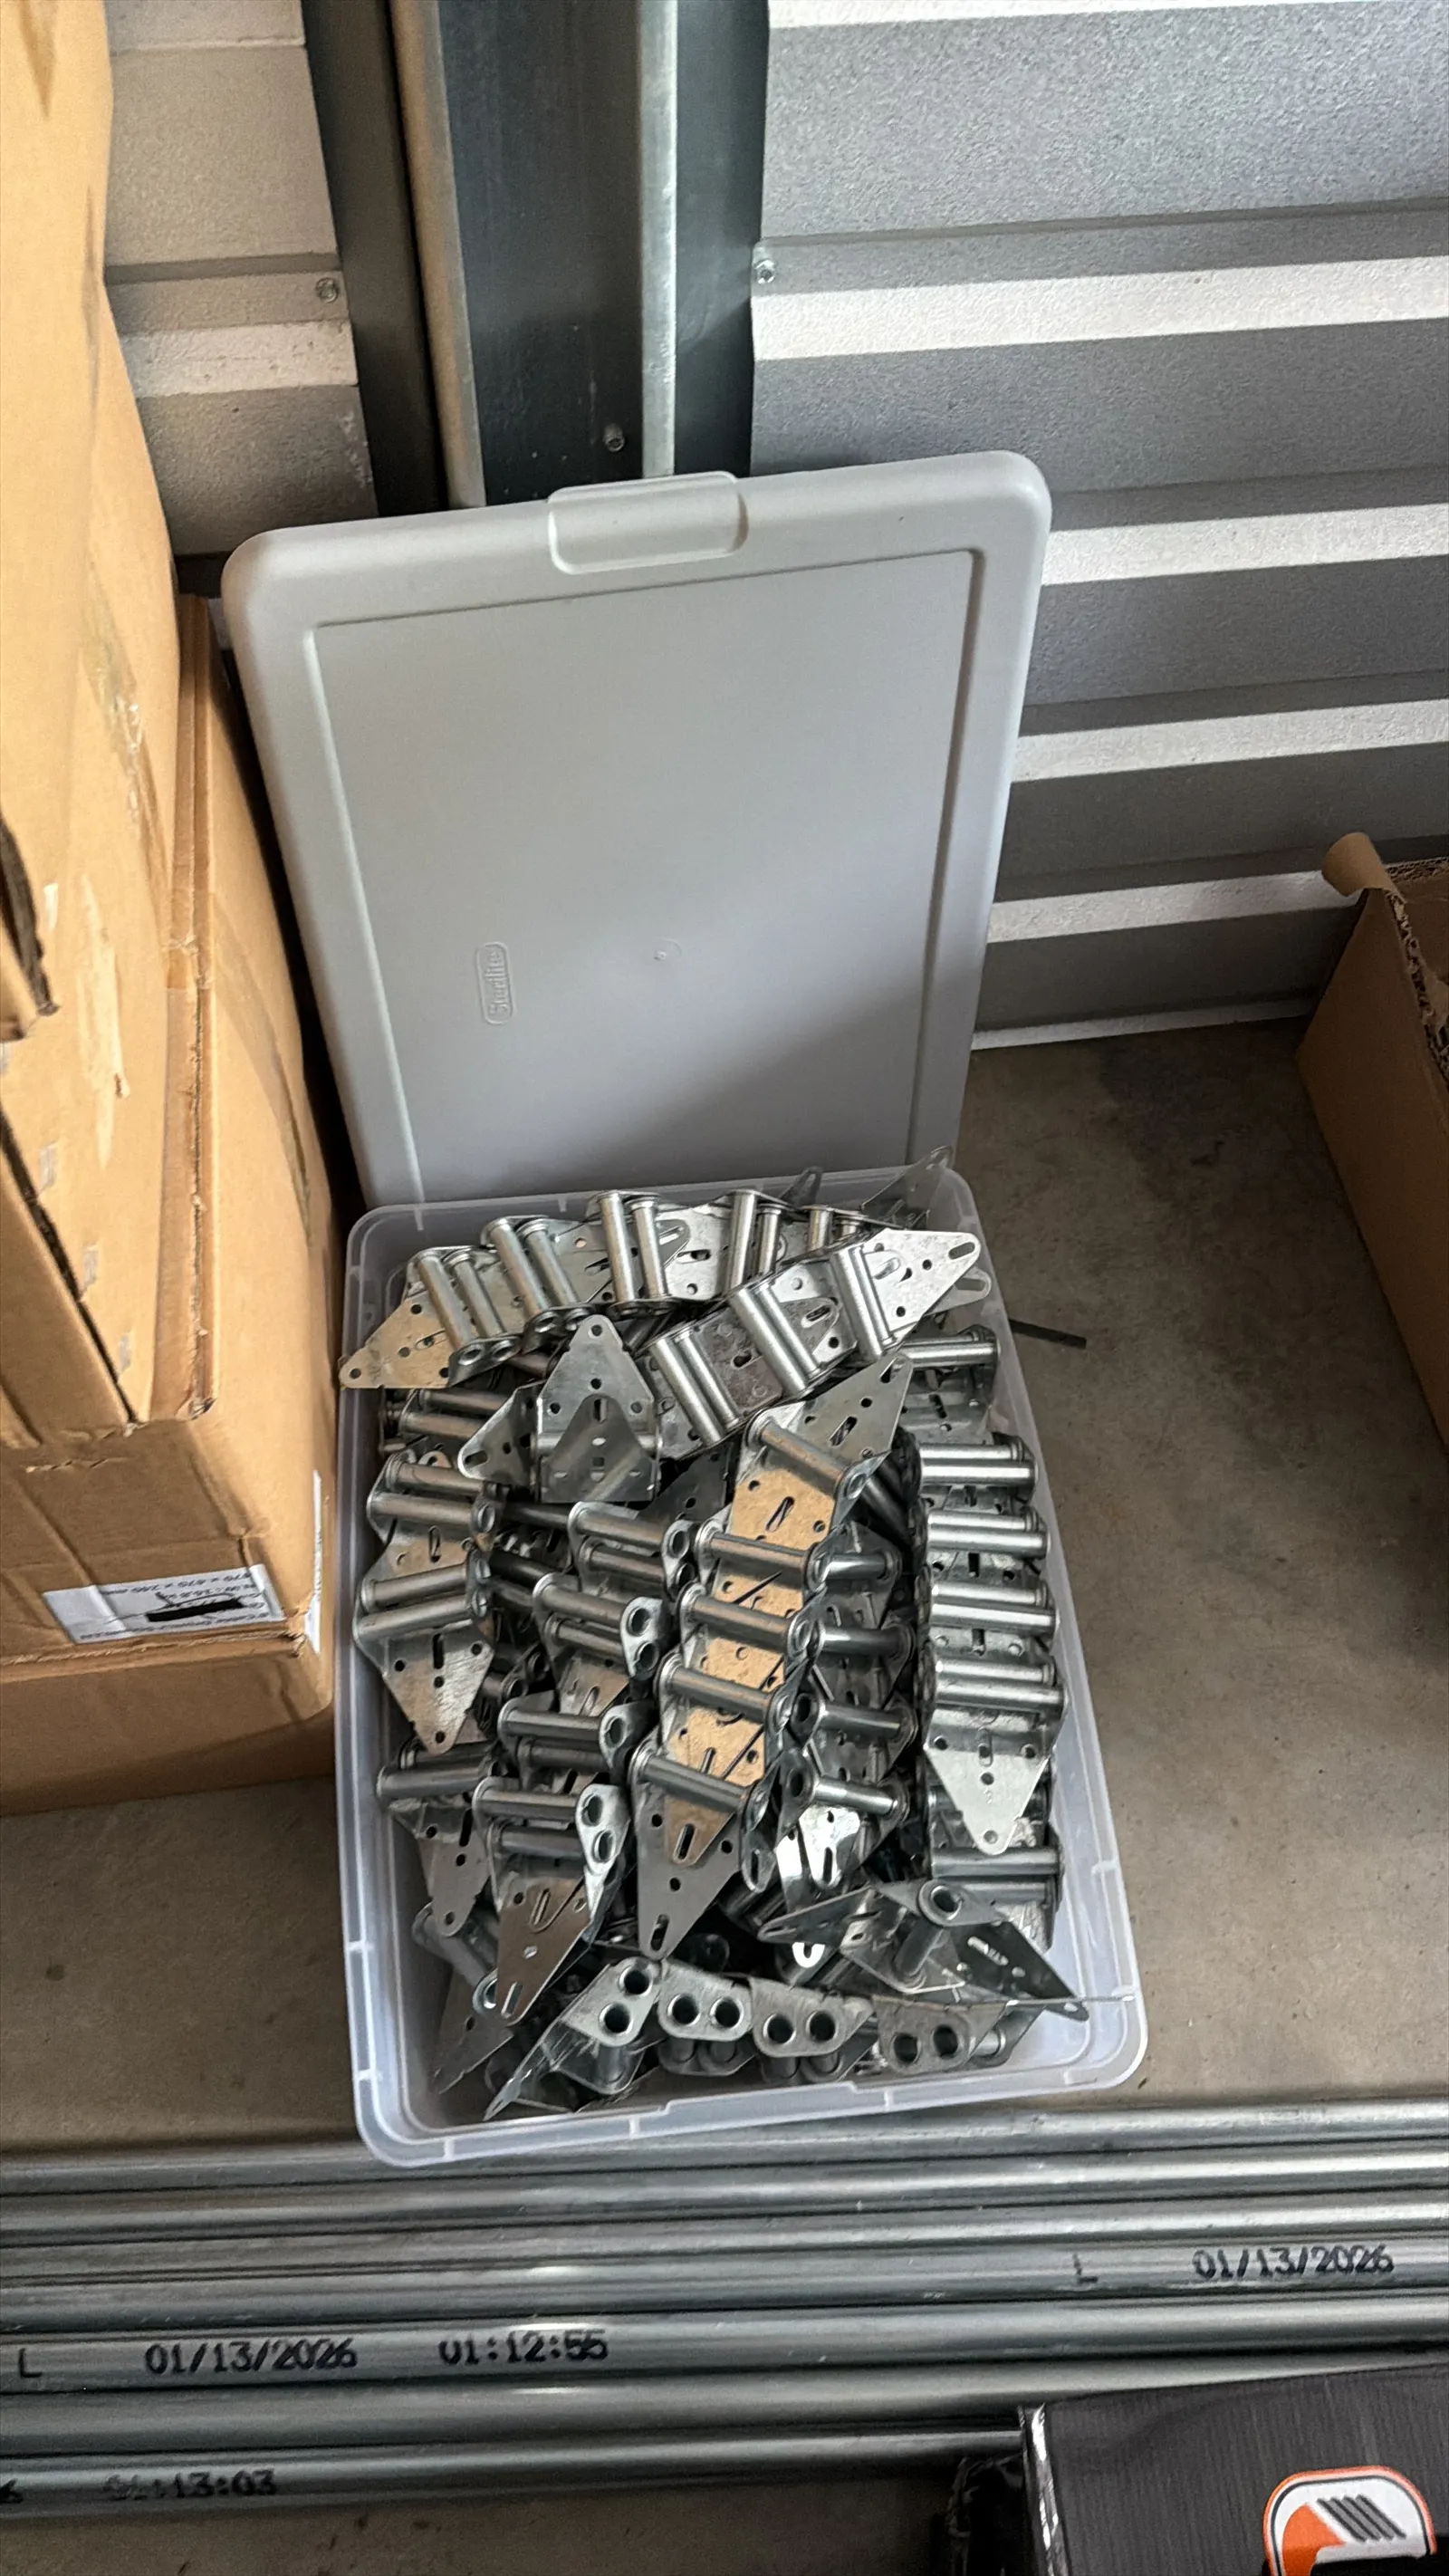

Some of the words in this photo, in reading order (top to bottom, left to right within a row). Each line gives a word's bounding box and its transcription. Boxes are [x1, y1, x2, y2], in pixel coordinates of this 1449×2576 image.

[1191, 2243, 1395, 2279] 01/13/2026
[18, 2348, 43, 2378] L
[144, 2337, 359, 2375] 01/13/2026
[438, 2329, 609, 2366] 01:12:55
